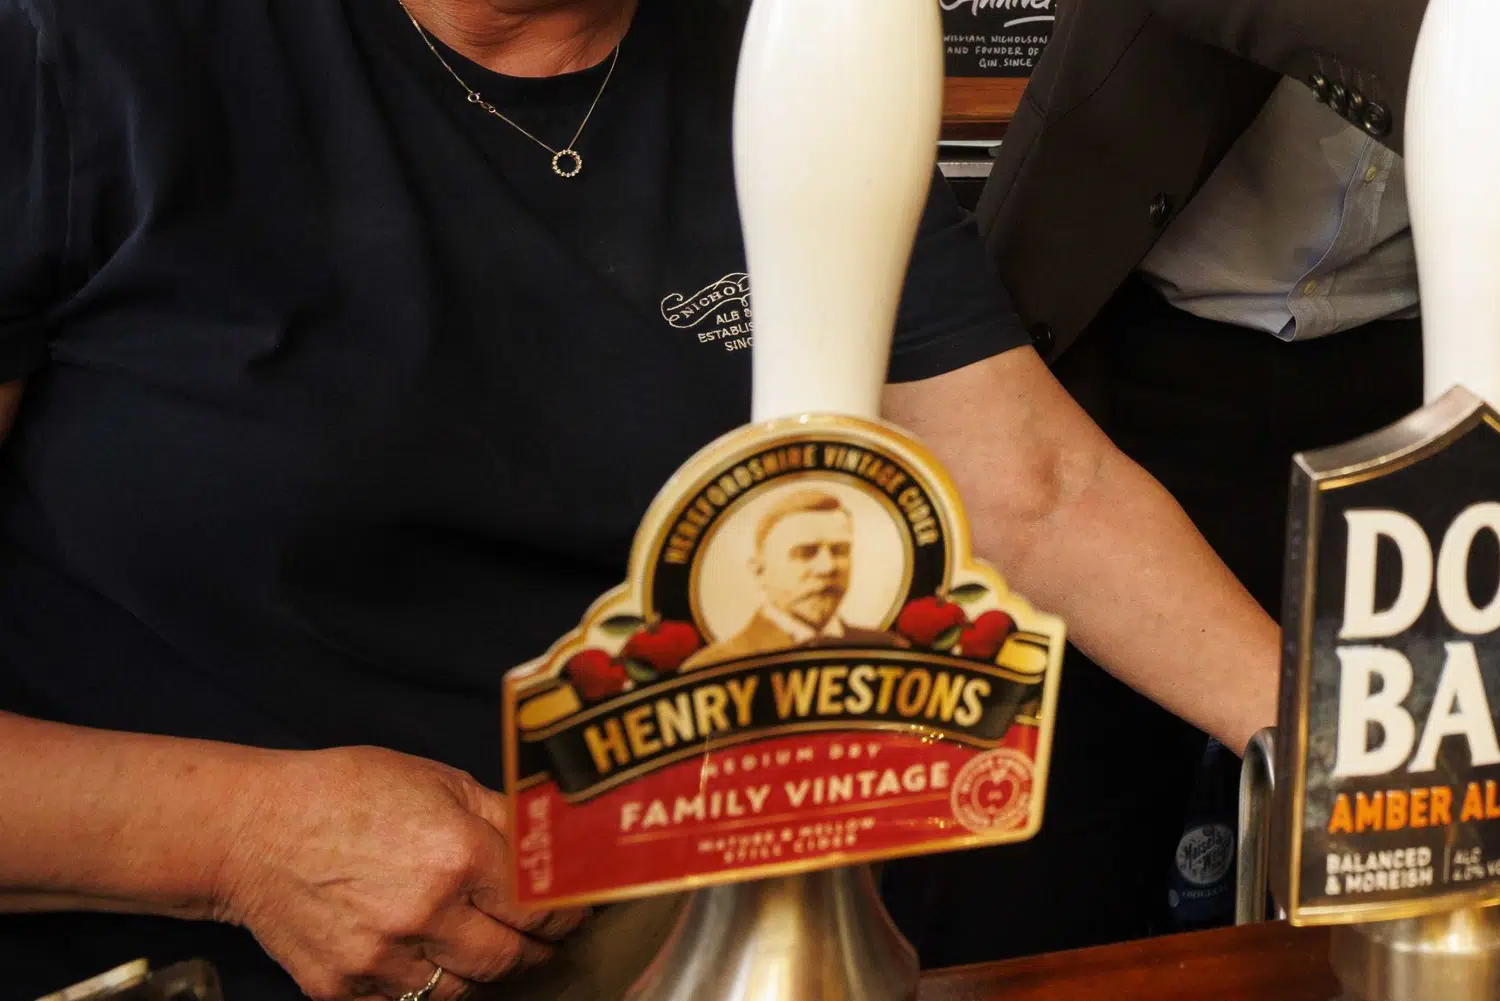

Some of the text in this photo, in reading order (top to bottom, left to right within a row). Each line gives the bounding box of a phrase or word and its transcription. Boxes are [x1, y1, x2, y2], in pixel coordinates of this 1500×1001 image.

[943, 34, 1049, 44] WILLIAM NICHOLSON
[947, 46, 1040, 56] AND FOUNDER OF
[1003, 58, 1033, 67] SINCE
[680, 283, 750, 318] NICHOL
[716, 310, 740, 325] ALE
[698, 322, 755, 343] ESTABLIS
[725, 337, 756, 351] SINC
[663, 443, 940, 564] HEREFORDSHIRE VINTAGE CIDER
[583, 663, 992, 774] HENRY WESTONS
[702, 742, 882, 781] MEDIUM DRY
[620, 785, 771, 832] FAMILY
[786, 760, 951, 808] VINTAGE
[1328, 785, 1453, 834] AMBER
[1326, 846, 1433, 874] BALANCED
[1345, 866, 1434, 893] MOREISH
